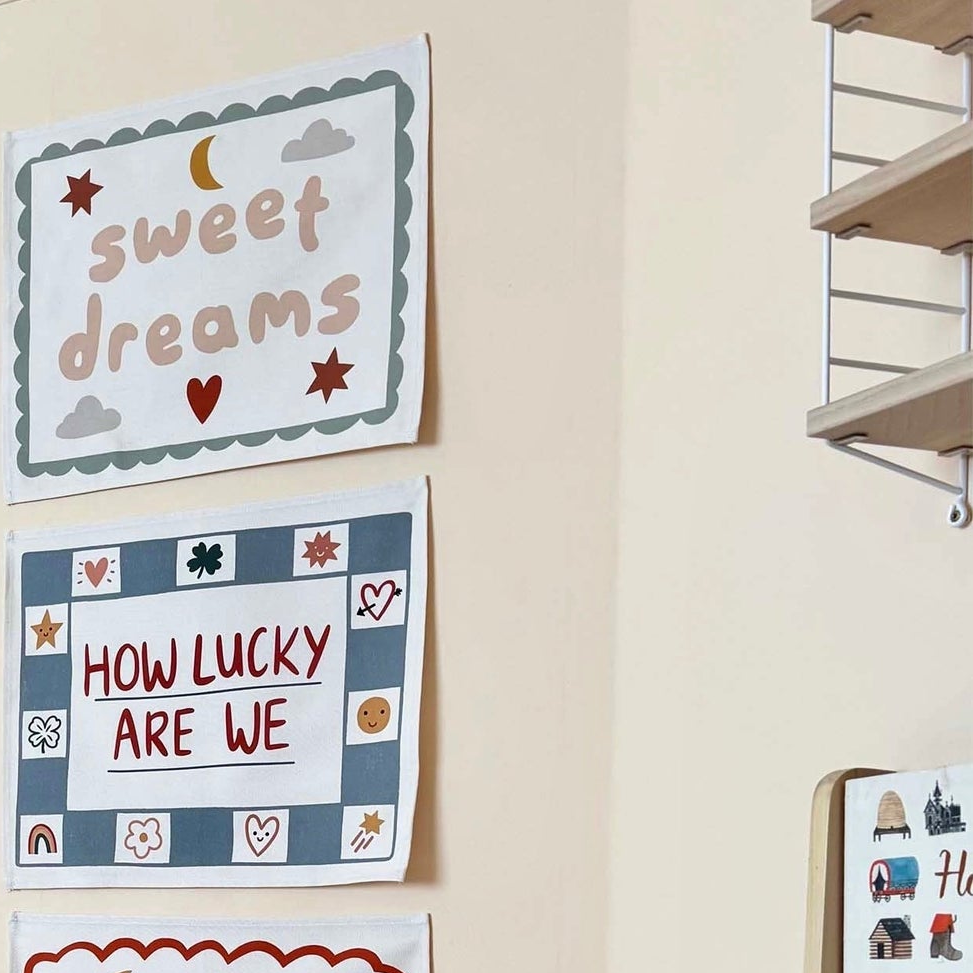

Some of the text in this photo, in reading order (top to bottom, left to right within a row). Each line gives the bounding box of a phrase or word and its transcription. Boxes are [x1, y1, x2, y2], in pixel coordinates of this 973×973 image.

[89, 176, 330, 283] sweet
[59, 274, 361, 381] dreams
[83, 624, 331, 697] HOW LUCKY
[113, 697, 290, 761] ARE WE
